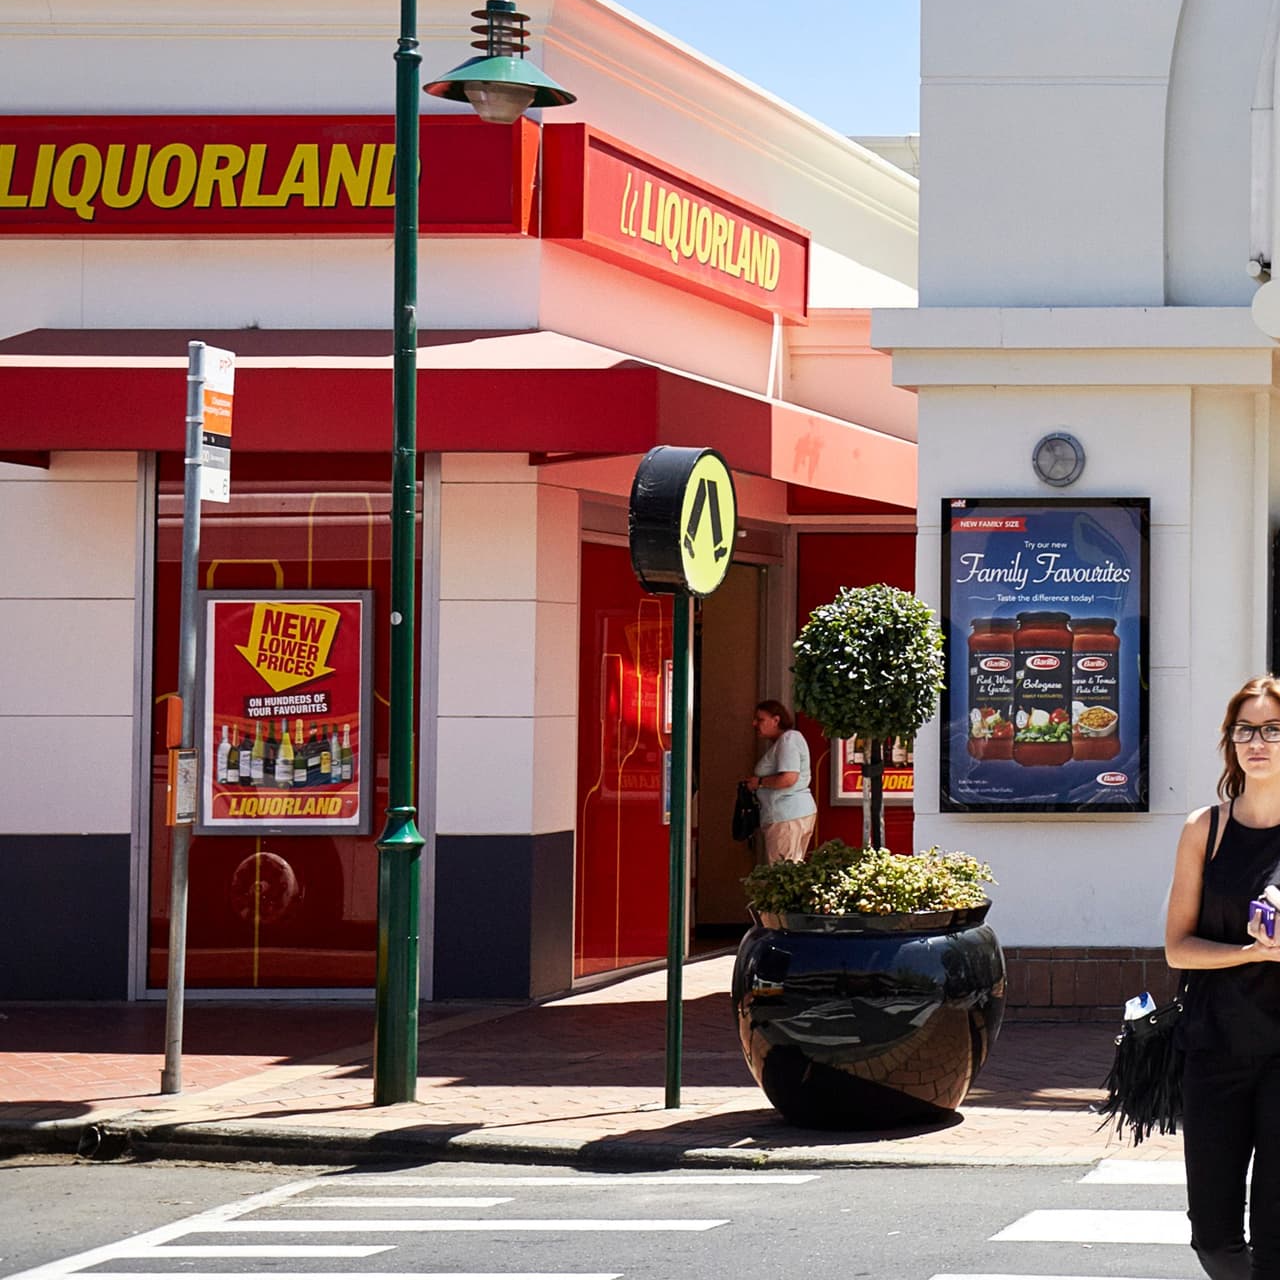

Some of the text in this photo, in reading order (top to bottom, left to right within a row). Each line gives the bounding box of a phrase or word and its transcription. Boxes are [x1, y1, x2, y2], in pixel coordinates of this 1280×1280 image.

[640, 180, 781, 292] LIQUORLAND
[1024, 541, 1036, 550] Try
[956, 551, 1131, 590] Family Favourites
[996, 594, 1095, 604] Taste the difference today!
[261, 609, 326, 644] NEW
[258, 635, 320, 662] LOWER
[255, 653, 315, 678] PRICES
[248, 702, 328, 717] YOUR FAVOURITES
[249, 693, 326, 708] ON HUNDREDS OF
[228, 796, 342, 818] LIQUORLAND
